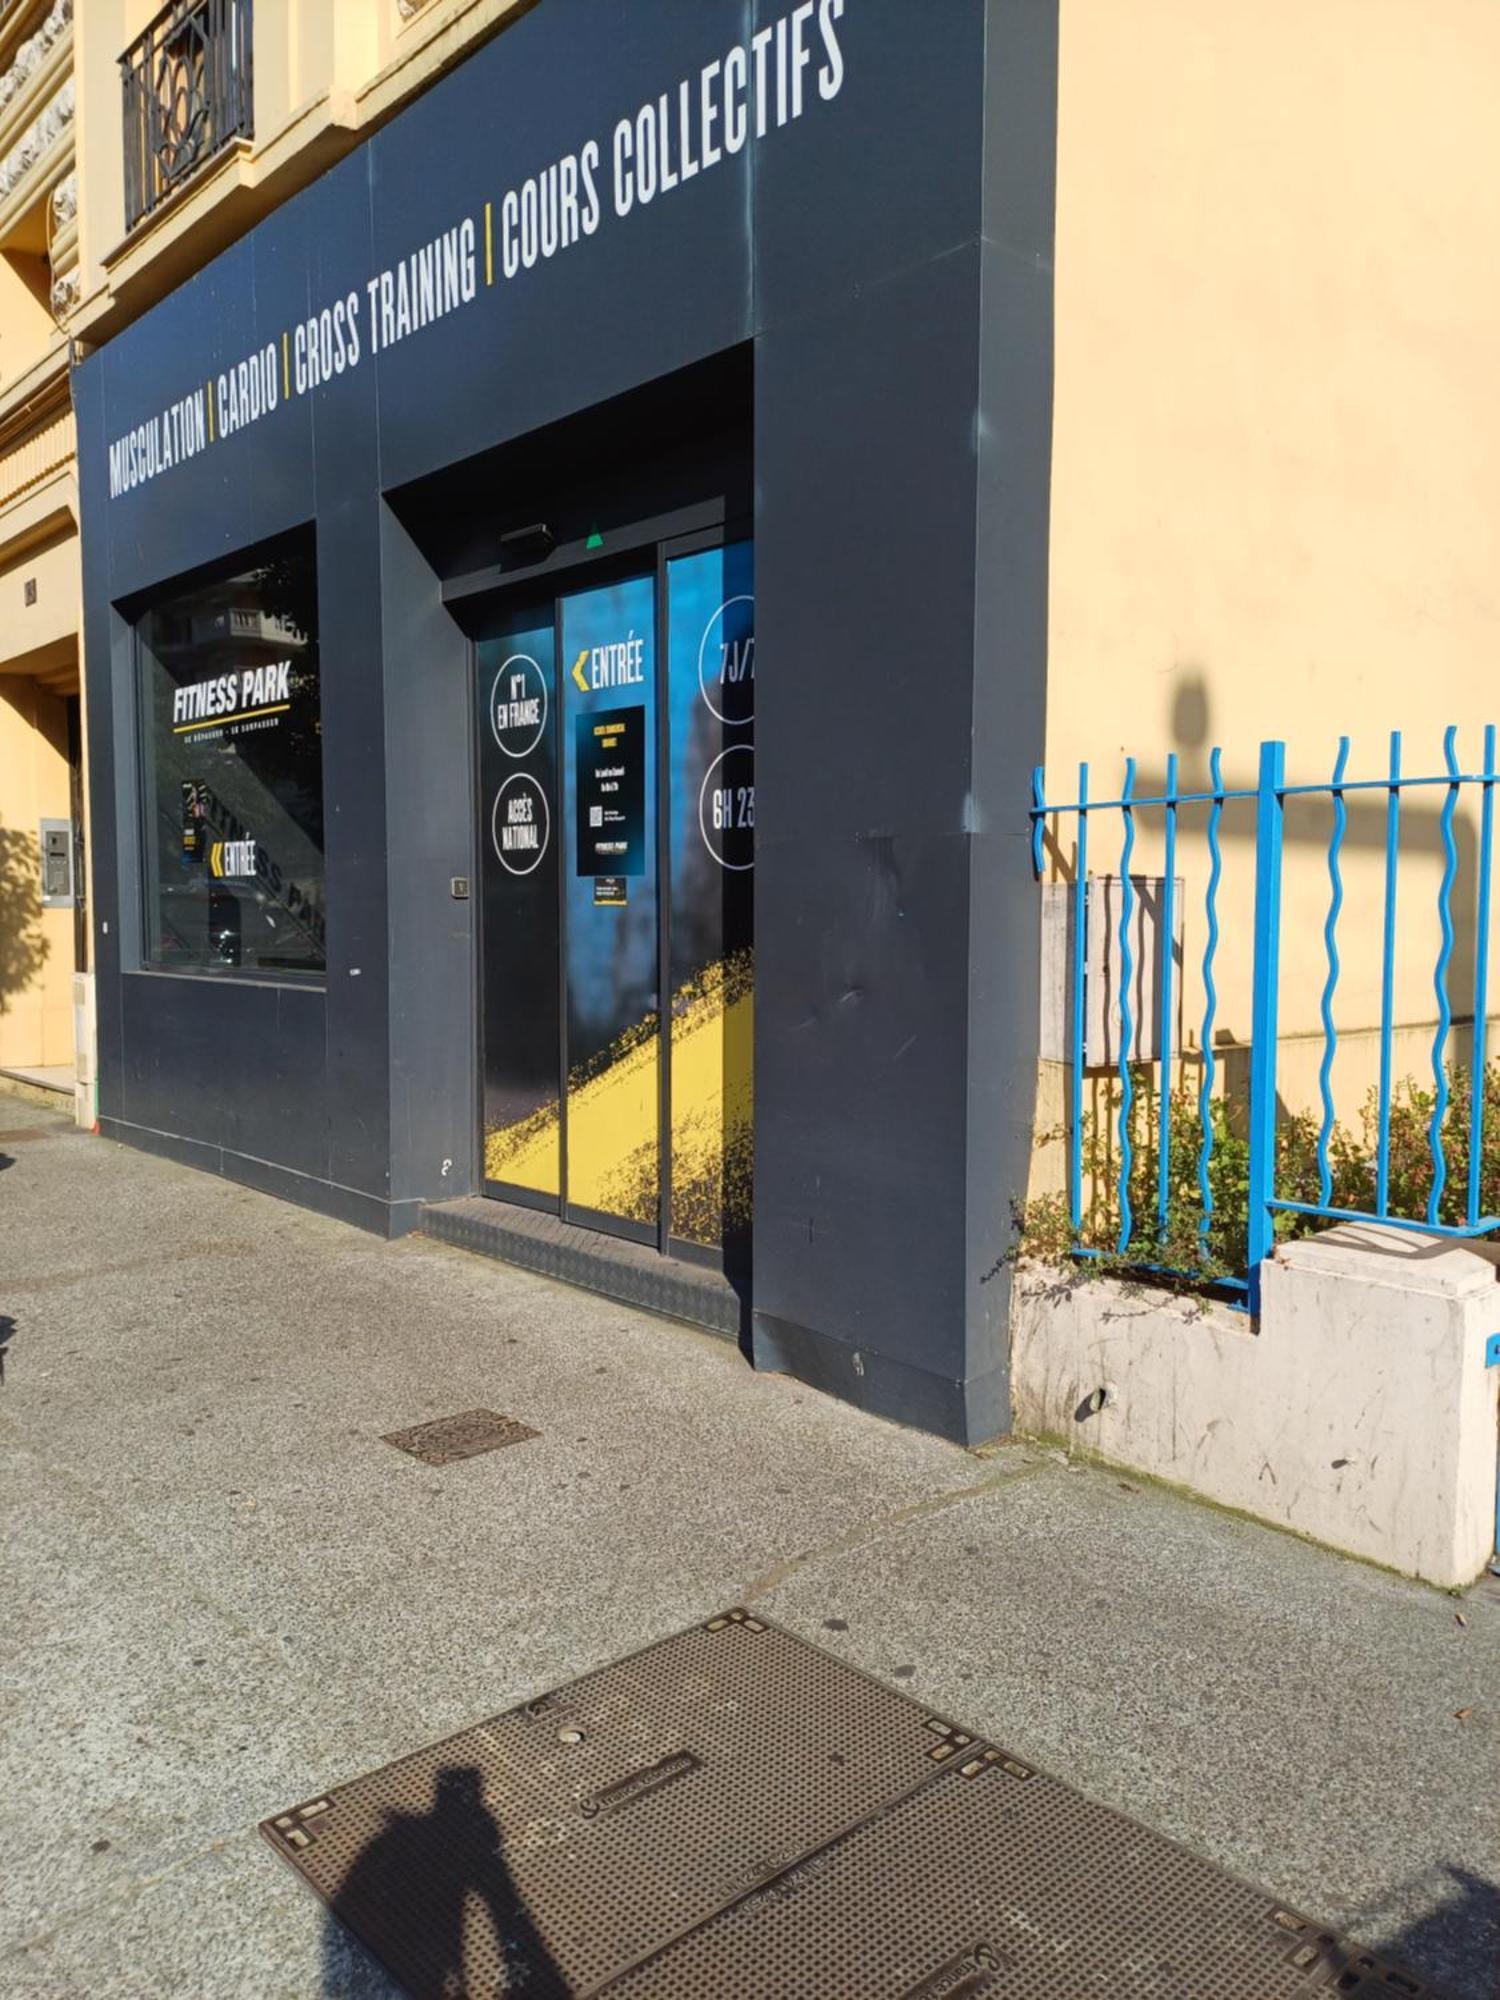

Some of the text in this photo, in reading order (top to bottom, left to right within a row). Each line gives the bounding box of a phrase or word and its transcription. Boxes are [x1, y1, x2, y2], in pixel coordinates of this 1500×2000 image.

[109, 0, 844, 499] MUSCULATION CARDIO CROSS TRAINING COURS COLLECTIFS
[591, 630, 644, 689] ENTRÉE
[173, 660, 291, 723] FITNESS PARK
[498, 698, 540, 729] EN FRANCE
[507, 792, 533, 824] ACCÈS
[713, 788, 732, 829] 6H
[224, 832, 257, 877] ENTRÉE
[502, 824, 539, 850] NATIONAL
